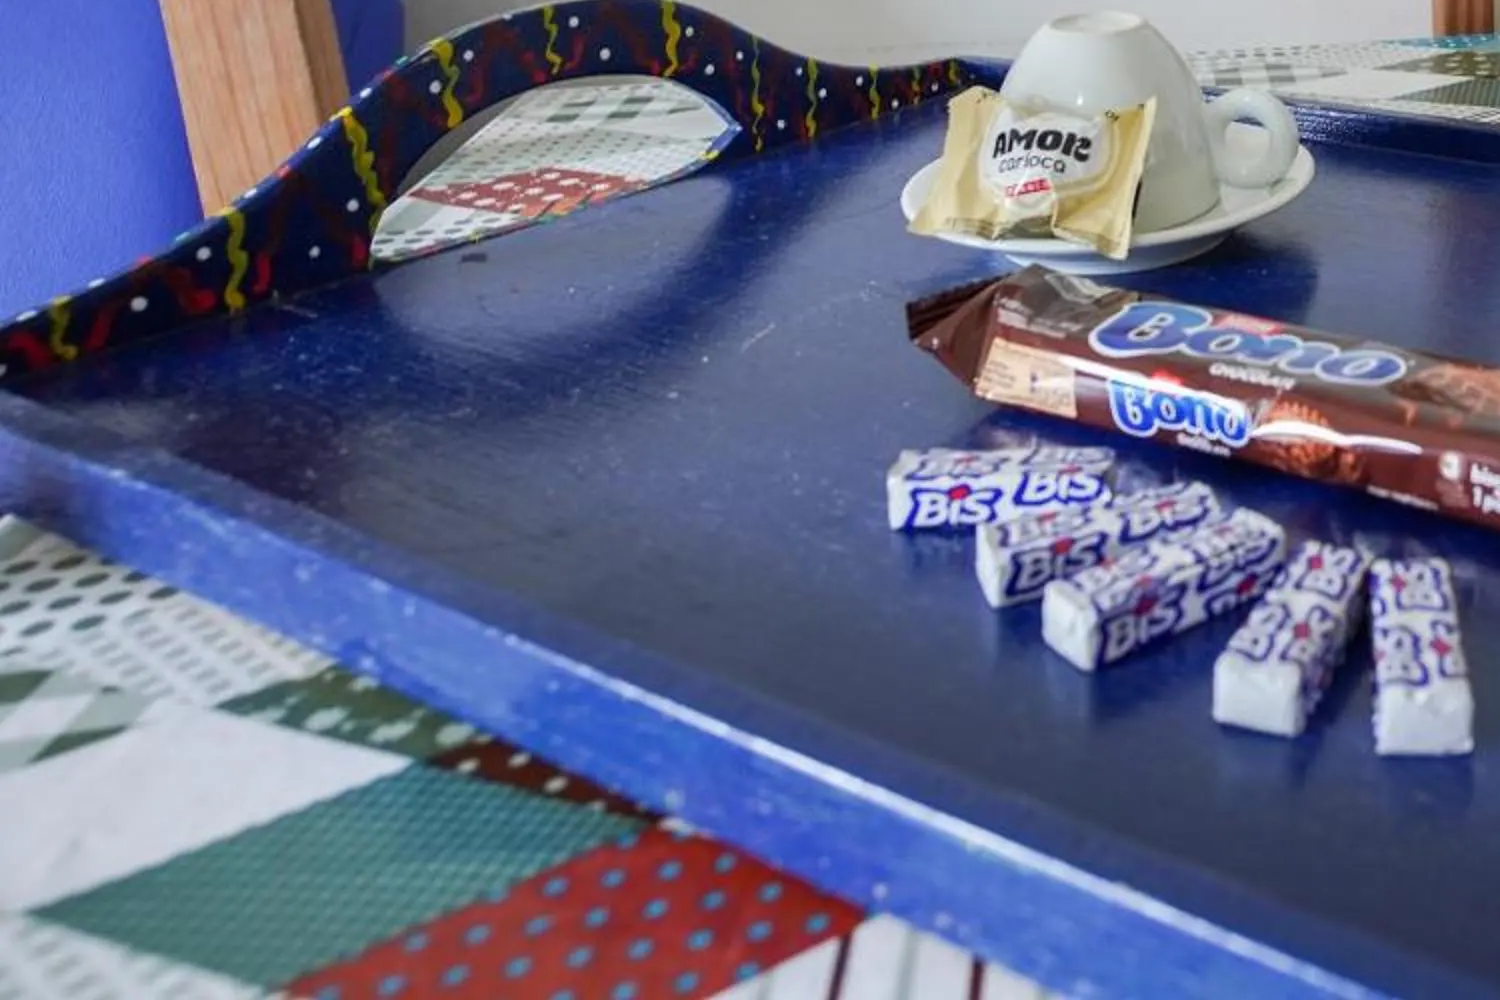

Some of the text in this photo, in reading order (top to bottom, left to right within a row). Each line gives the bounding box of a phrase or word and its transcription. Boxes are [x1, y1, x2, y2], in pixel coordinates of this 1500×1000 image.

[992, 127, 1093, 163] AMOR
[998, 153, 1067, 174] carioca
[1089, 301, 1406, 386] Bono
[1106, 378, 1251, 448] Bono
